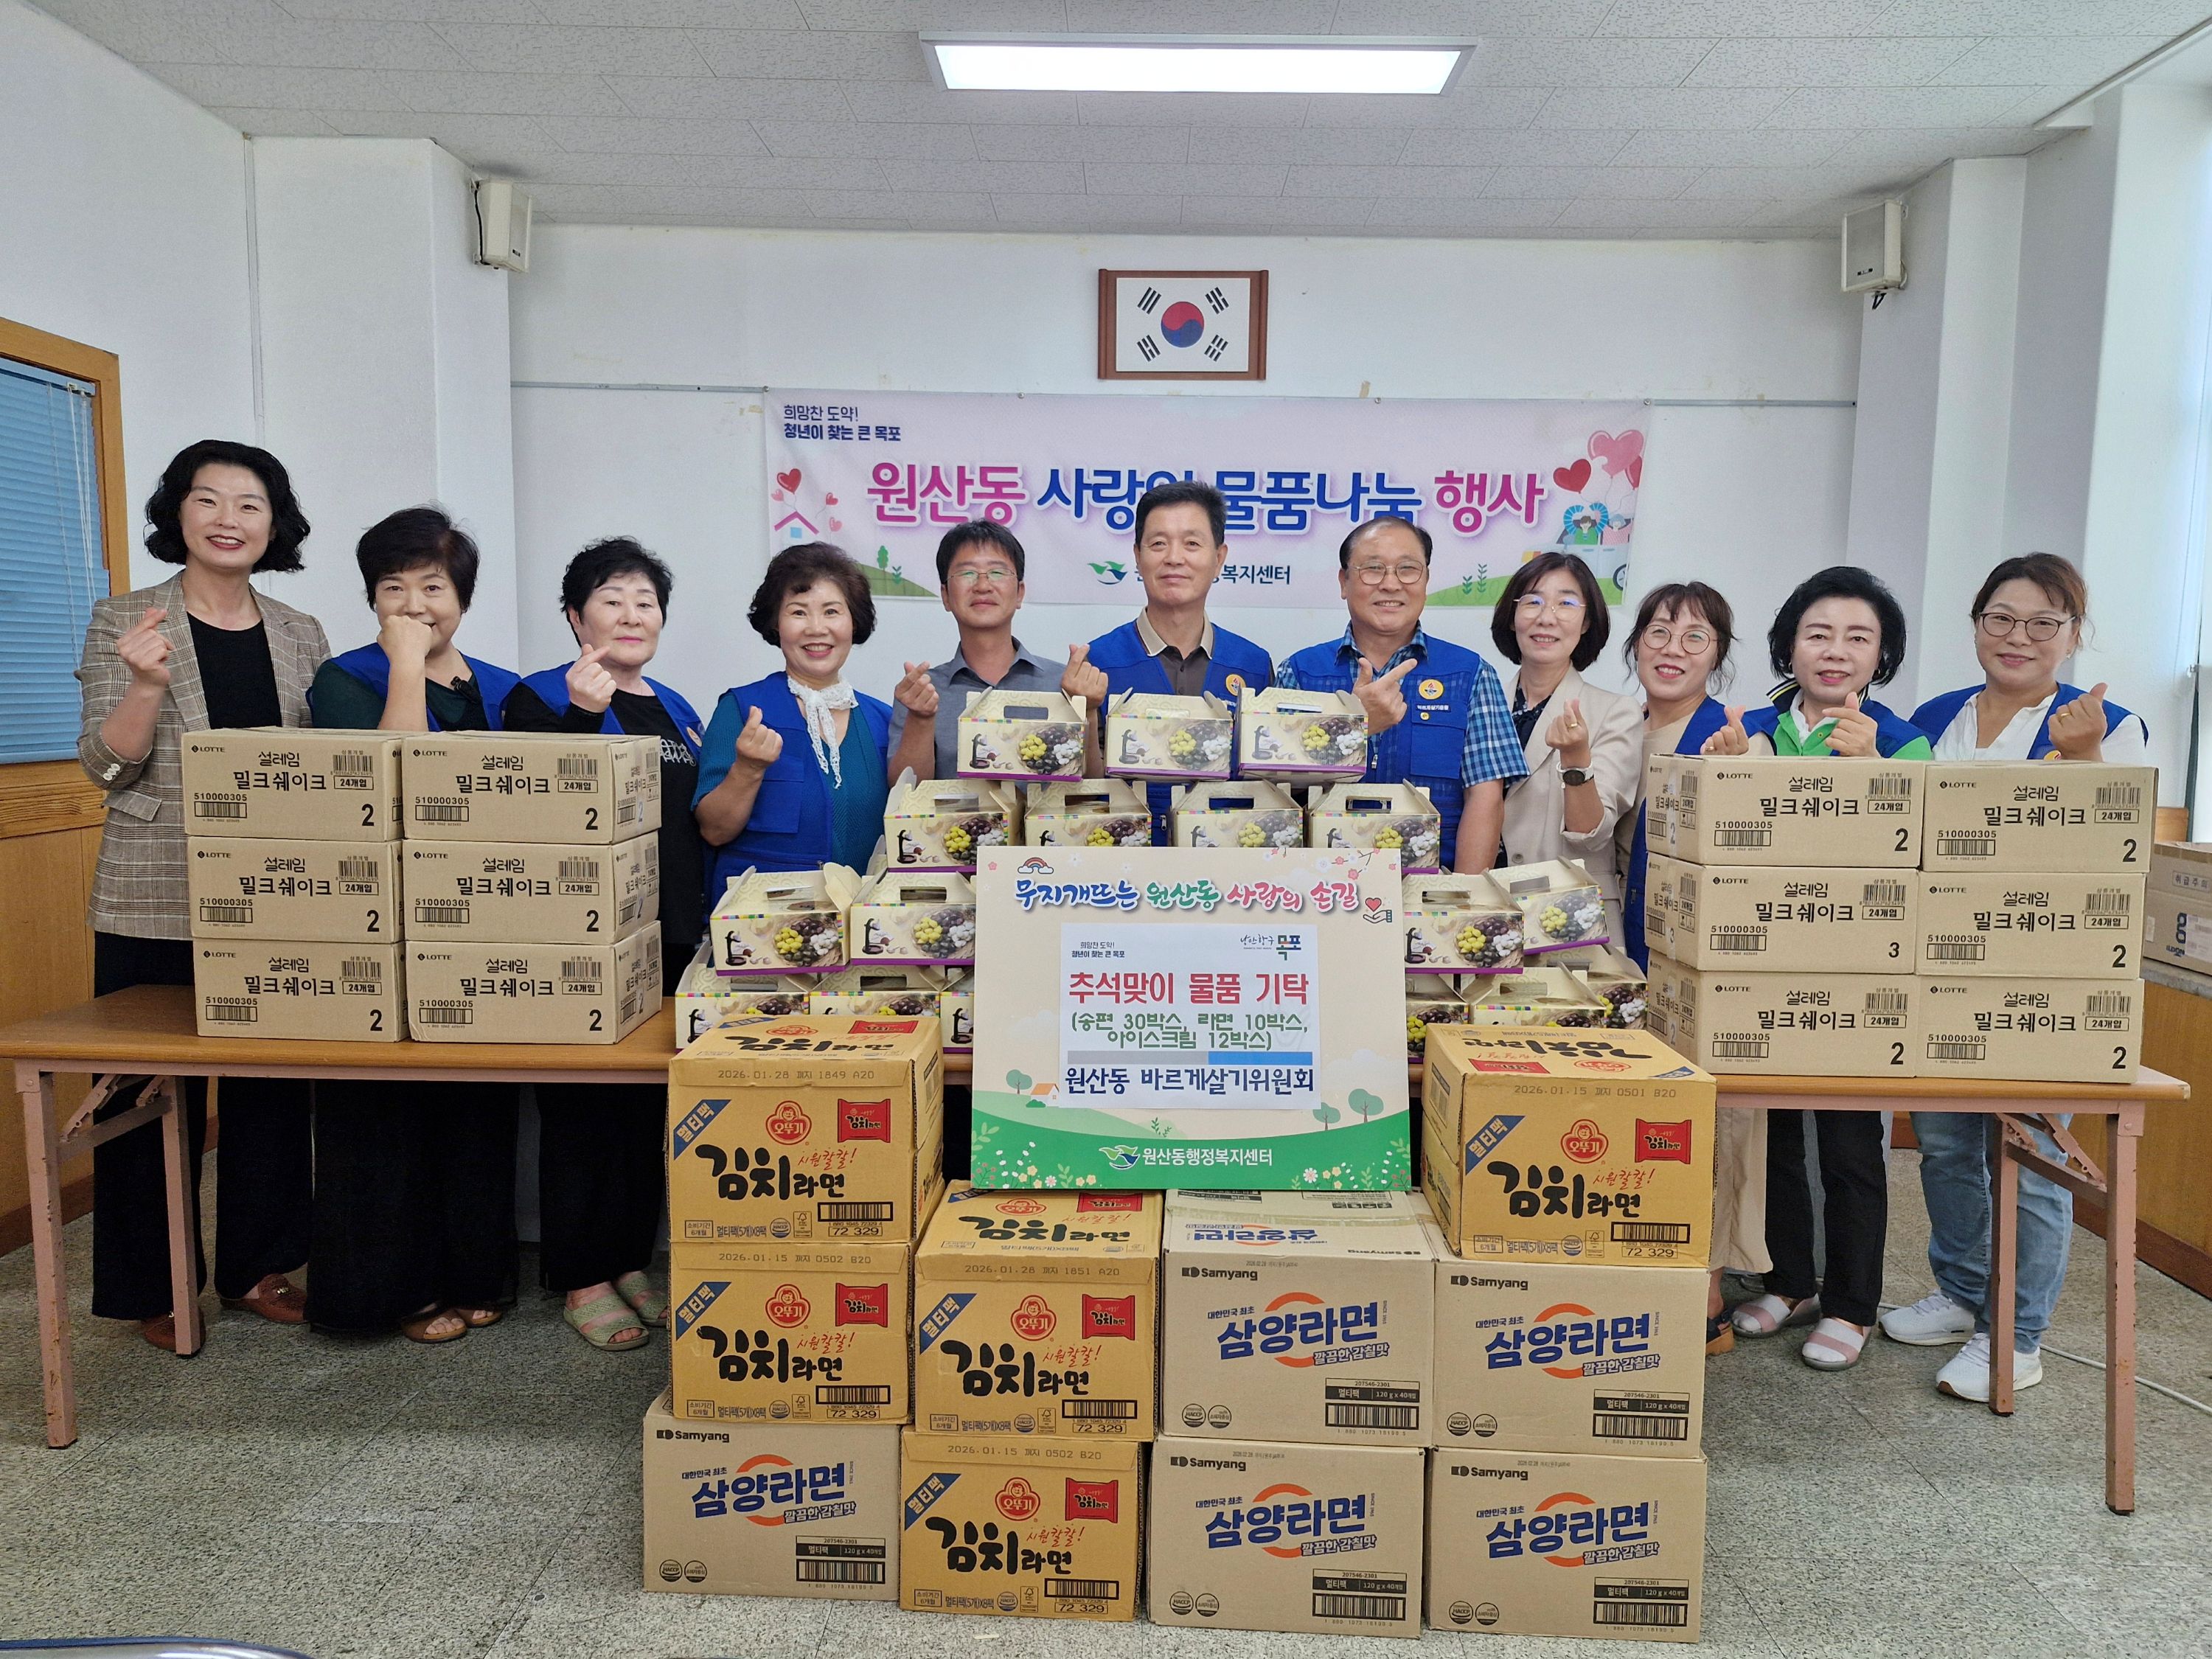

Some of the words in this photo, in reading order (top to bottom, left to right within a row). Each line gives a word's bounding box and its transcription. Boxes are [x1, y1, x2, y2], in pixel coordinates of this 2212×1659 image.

[783, 404, 824, 421] 희망찬
[827, 406, 859, 422] 도약!
[783, 424, 824, 439] 청년이
[827, 425, 854, 441] 찾는
[857, 425, 871, 441] 큰
[875, 426, 901, 442] 목포
[867, 462, 1026, 525] 원산동
[1434, 470, 1545, 533] 행사
[258, 751, 300, 768] 설레임
[481, 755, 524, 771] 설레임
[234, 771, 327, 791] 밀크쉐이크
[340, 779, 367, 787] 24개입
[456, 775, 550, 795] 밀크쉐이크
[564, 782, 591, 791] 24개입
[1788, 776, 1834, 793] 설레임
[194, 793, 247, 801] 510000305
[415, 796, 470, 804] 510000305
[2013, 786, 2059, 801] 설레임
[361, 804, 375, 826] 2
[1760, 797, 1860, 817] 밀크쉐이크
[1874, 802, 1903, 811] 24개입
[585, 808, 598, 830] 2
[1715, 821, 1773, 829] 510000305
[1983, 806, 2086, 827] 밀크쉐이크
[2101, 812, 2131, 821] 24개입
[1894, 828, 1908, 851] 2
[264, 858, 305, 873] 설레임
[482, 858, 525, 873] 설레임
[239, 876, 333, 897] 밀크쉐이크
[456, 877, 552, 897] 밀크쉐이크
[1784, 882, 1829, 898] 설레임
[1015, 880, 1138, 908] 무지개뜨는
[1147, 882, 1221, 908] 원산동
[1227, 883, 1301, 910] 사랑의
[1310, 883, 1359, 911] 손길
[2003, 891, 2049, 907] 설레임
[1756, 902, 1854, 922] 밀크쉐이크
[1973, 911, 2076, 932] 밀크쉐이크
[1888, 942, 1899, 958] 3
[268, 957, 310, 973] 설레임
[486, 959, 528, 973] 설레임
[244, 975, 335, 996] 밀크쉐이크
[460, 978, 554, 998] 밀크쉐이크
[1069, 972, 1175, 1005] 추석맞이
[1189, 973, 1241, 1004] 물품
[1256, 973, 1310, 1005] 기탁
[1786, 991, 1830, 1006] 설레임
[2003, 992, 2050, 1009] 설레임
[1072, 1012, 1113, 1032] (송편
[1124, 1013, 1188, 1032] 30박스,
[1197, 1013, 1234, 1032] 라면
[1246, 1015, 1308, 1033] 10박스,
[1758, 1010, 1856, 1031] 밀크쉐이크
[1974, 1012, 2076, 1033] 밀크쉐이크
[1107, 1032, 1197, 1049] 아이스크림
[1208, 1032, 1273, 1050] 12박스)
[2112, 1047, 2126, 1069] 2
[718, 1070, 790, 1079] 2026.01.28
[819, 1071, 846, 1079] 1849
[853, 1071, 874, 1079] A20
[1065, 1068, 1130, 1094] 원산동
[1141, 1068, 1314, 1094] 바르게살기위원회
[1514, 1085, 1587, 1095] 2026.01.15
[677, 1102, 714, 1141] 멀티팩
[774, 1123, 803, 1135] 오뚜기
[1468, 1118, 1509, 1158] 멀티팩
[1570, 1141, 1600, 1153] 오뚜기
[1143, 1147, 1273, 1167] 원산동행정복지센터
[695, 1144, 845, 1200] 김치라면
[1487, 1161, 1640, 1219] 김치라면
[832, 1227, 848, 1236] 72
[854, 1227, 879, 1236] 329
[719, 1253, 787, 1262] 2026.01.15
[1626, 1248, 1643, 1257] 72
[1648, 1248, 1674, 1258] 329
[964, 1265, 1035, 1273] 2026.01.28
[1099, 1267, 1119, 1276] A20
[1202, 1268, 1258, 1280] Samyang
[1471, 1276, 1528, 1290] Samyang
[678, 1284, 715, 1323] 멀티팩
[774, 1307, 802, 1318] 오뚜기
[922, 1297, 960, 1337] 멀티팩
[1208, 1308, 1237, 1320] 대한민국
[1239, 1306, 1255, 1315] 최초
[1019, 1318, 1048, 1329] 오뚜기
[1217, 1301, 1377, 1360] 삼양라면
[1475, 1318, 1506, 1329] 대한민국
[1509, 1316, 1524, 1326] 최초
[1485, 1313, 1649, 1369] 삼양라면
[696, 1325, 842, 1382] 김치라면
[1313, 1351, 1351, 1366] 깔끔한
[1352, 1342, 1390, 1361] 감칠맛
[940, 1340, 1089, 1397] 김치라면
[1583, 1362, 1621, 1377] 깔끔한
[1621, 1354, 1660, 1373] 감칠맛
[1338, 1388, 1360, 1398] 멀티팩
[831, 1410, 846, 1418] 72
[852, 1410, 877, 1419] 329
[675, 1430, 729, 1442] Samyang
[1077, 1424, 1092, 1433] 72
[1097, 1425, 1123, 1433] 329
[947, 1445, 1018, 1455] 2026.01.15
[1190, 1458, 1246, 1471] Samyang
[682, 1468, 711, 1480] 대한민국
[713, 1467, 727, 1475] 최초
[1471, 1467, 1528, 1481] Samyang
[692, 1462, 845, 1518] 삼양라면
[908, 1476, 945, 1513] 멀티팩
[1004, 1498, 1032, 1511] 오뚜기
[1195, 1498, 1226, 1509] 대한민국
[1228, 1497, 1242, 1505] 최초
[784, 1507, 820, 1524] 깔끔한
[820, 1502, 857, 1519] 감칠맛
[1476, 1507, 1507, 1518] 대한민국
[1509, 1506, 1524, 1514] 최초
[1205, 1494, 1366, 1548] 삼양라면
[1486, 1502, 1649, 1558] 삼양라면
[925, 1516, 1071, 1574] 김치라면
[1301, 1543, 1338, 1557] 깔끔한
[1339, 1534, 1377, 1552] 감칠맛
[1584, 1550, 1621, 1565] 깔끔한
[1621, 1542, 1660, 1561] 감칠맛
